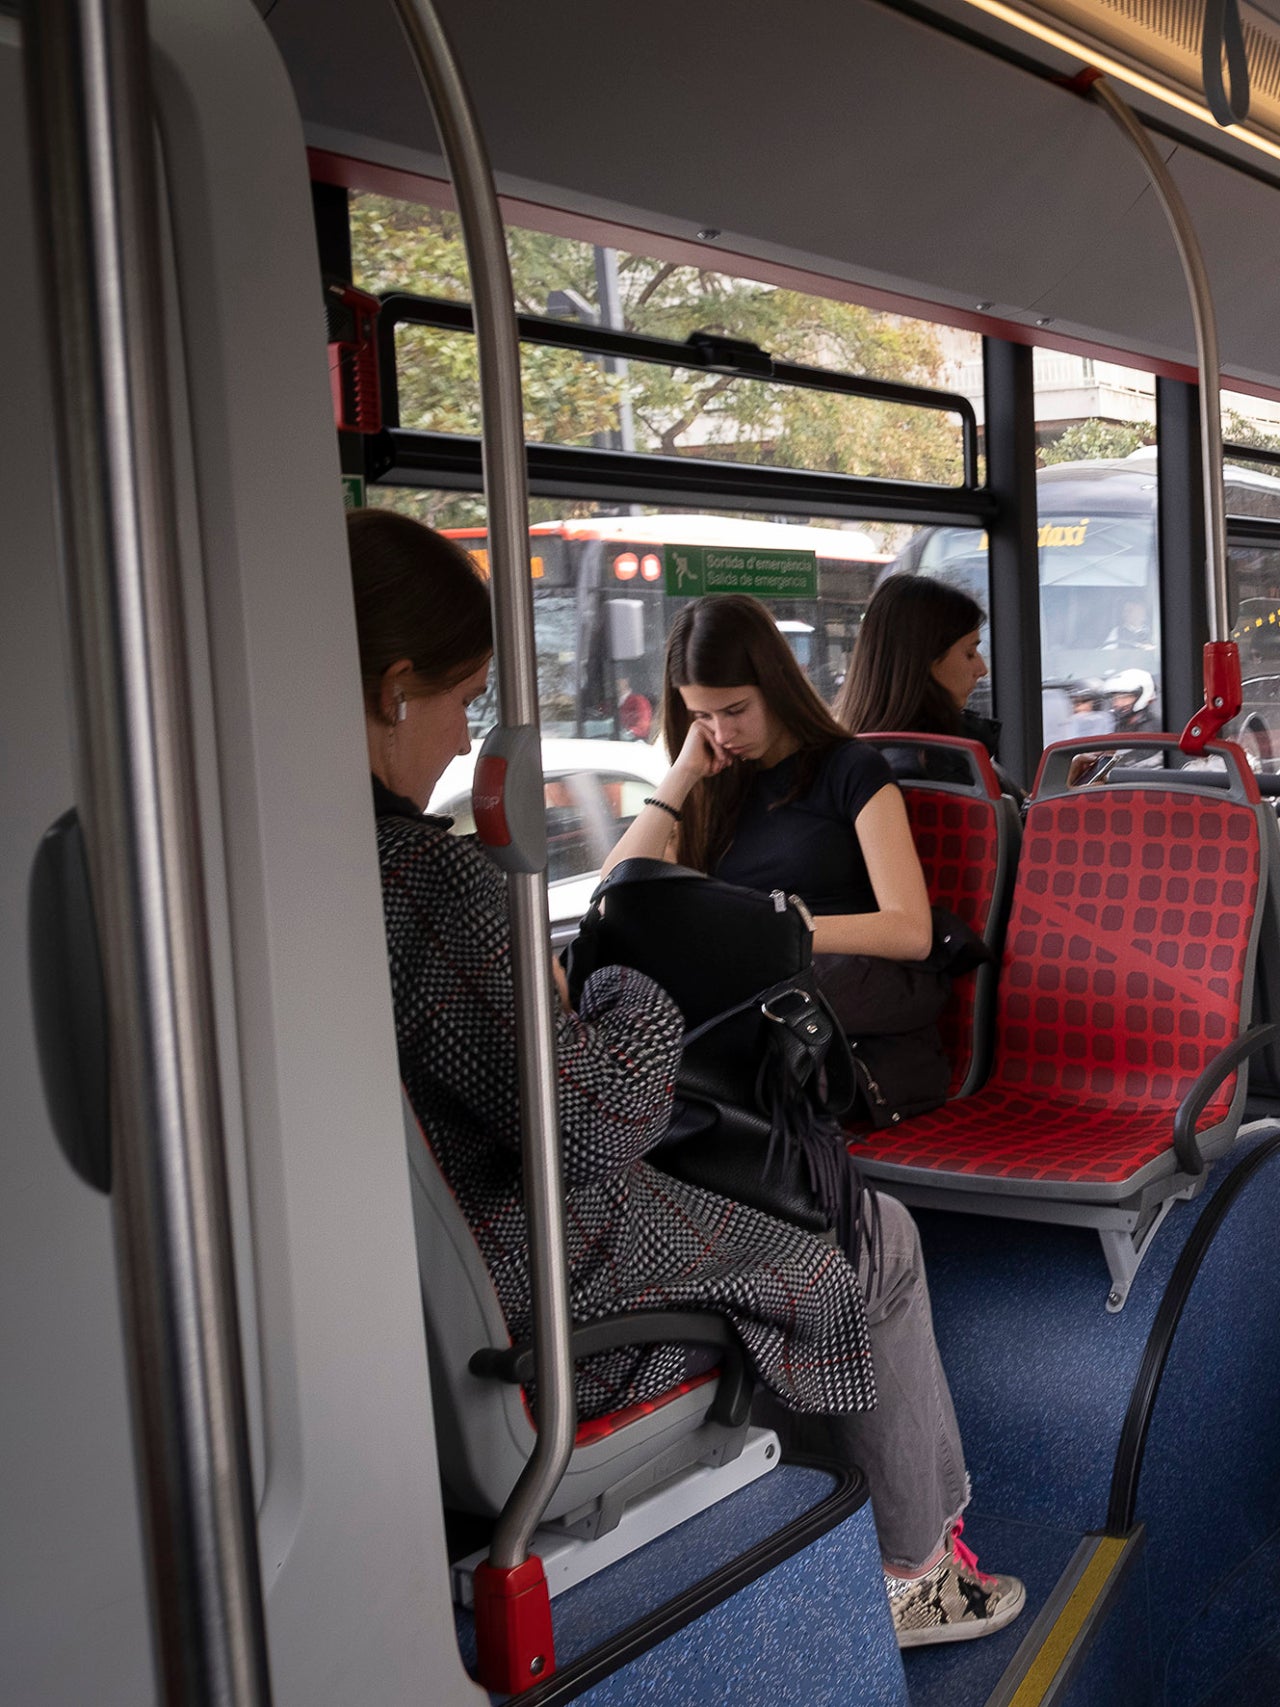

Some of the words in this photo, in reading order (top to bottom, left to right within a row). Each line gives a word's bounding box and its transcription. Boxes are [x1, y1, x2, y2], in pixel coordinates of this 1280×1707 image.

[706, 554, 744, 569] Sortida
[707, 570, 738, 586] Salida
[740, 573, 752, 586] de
[755, 575, 807, 590] emergencia
